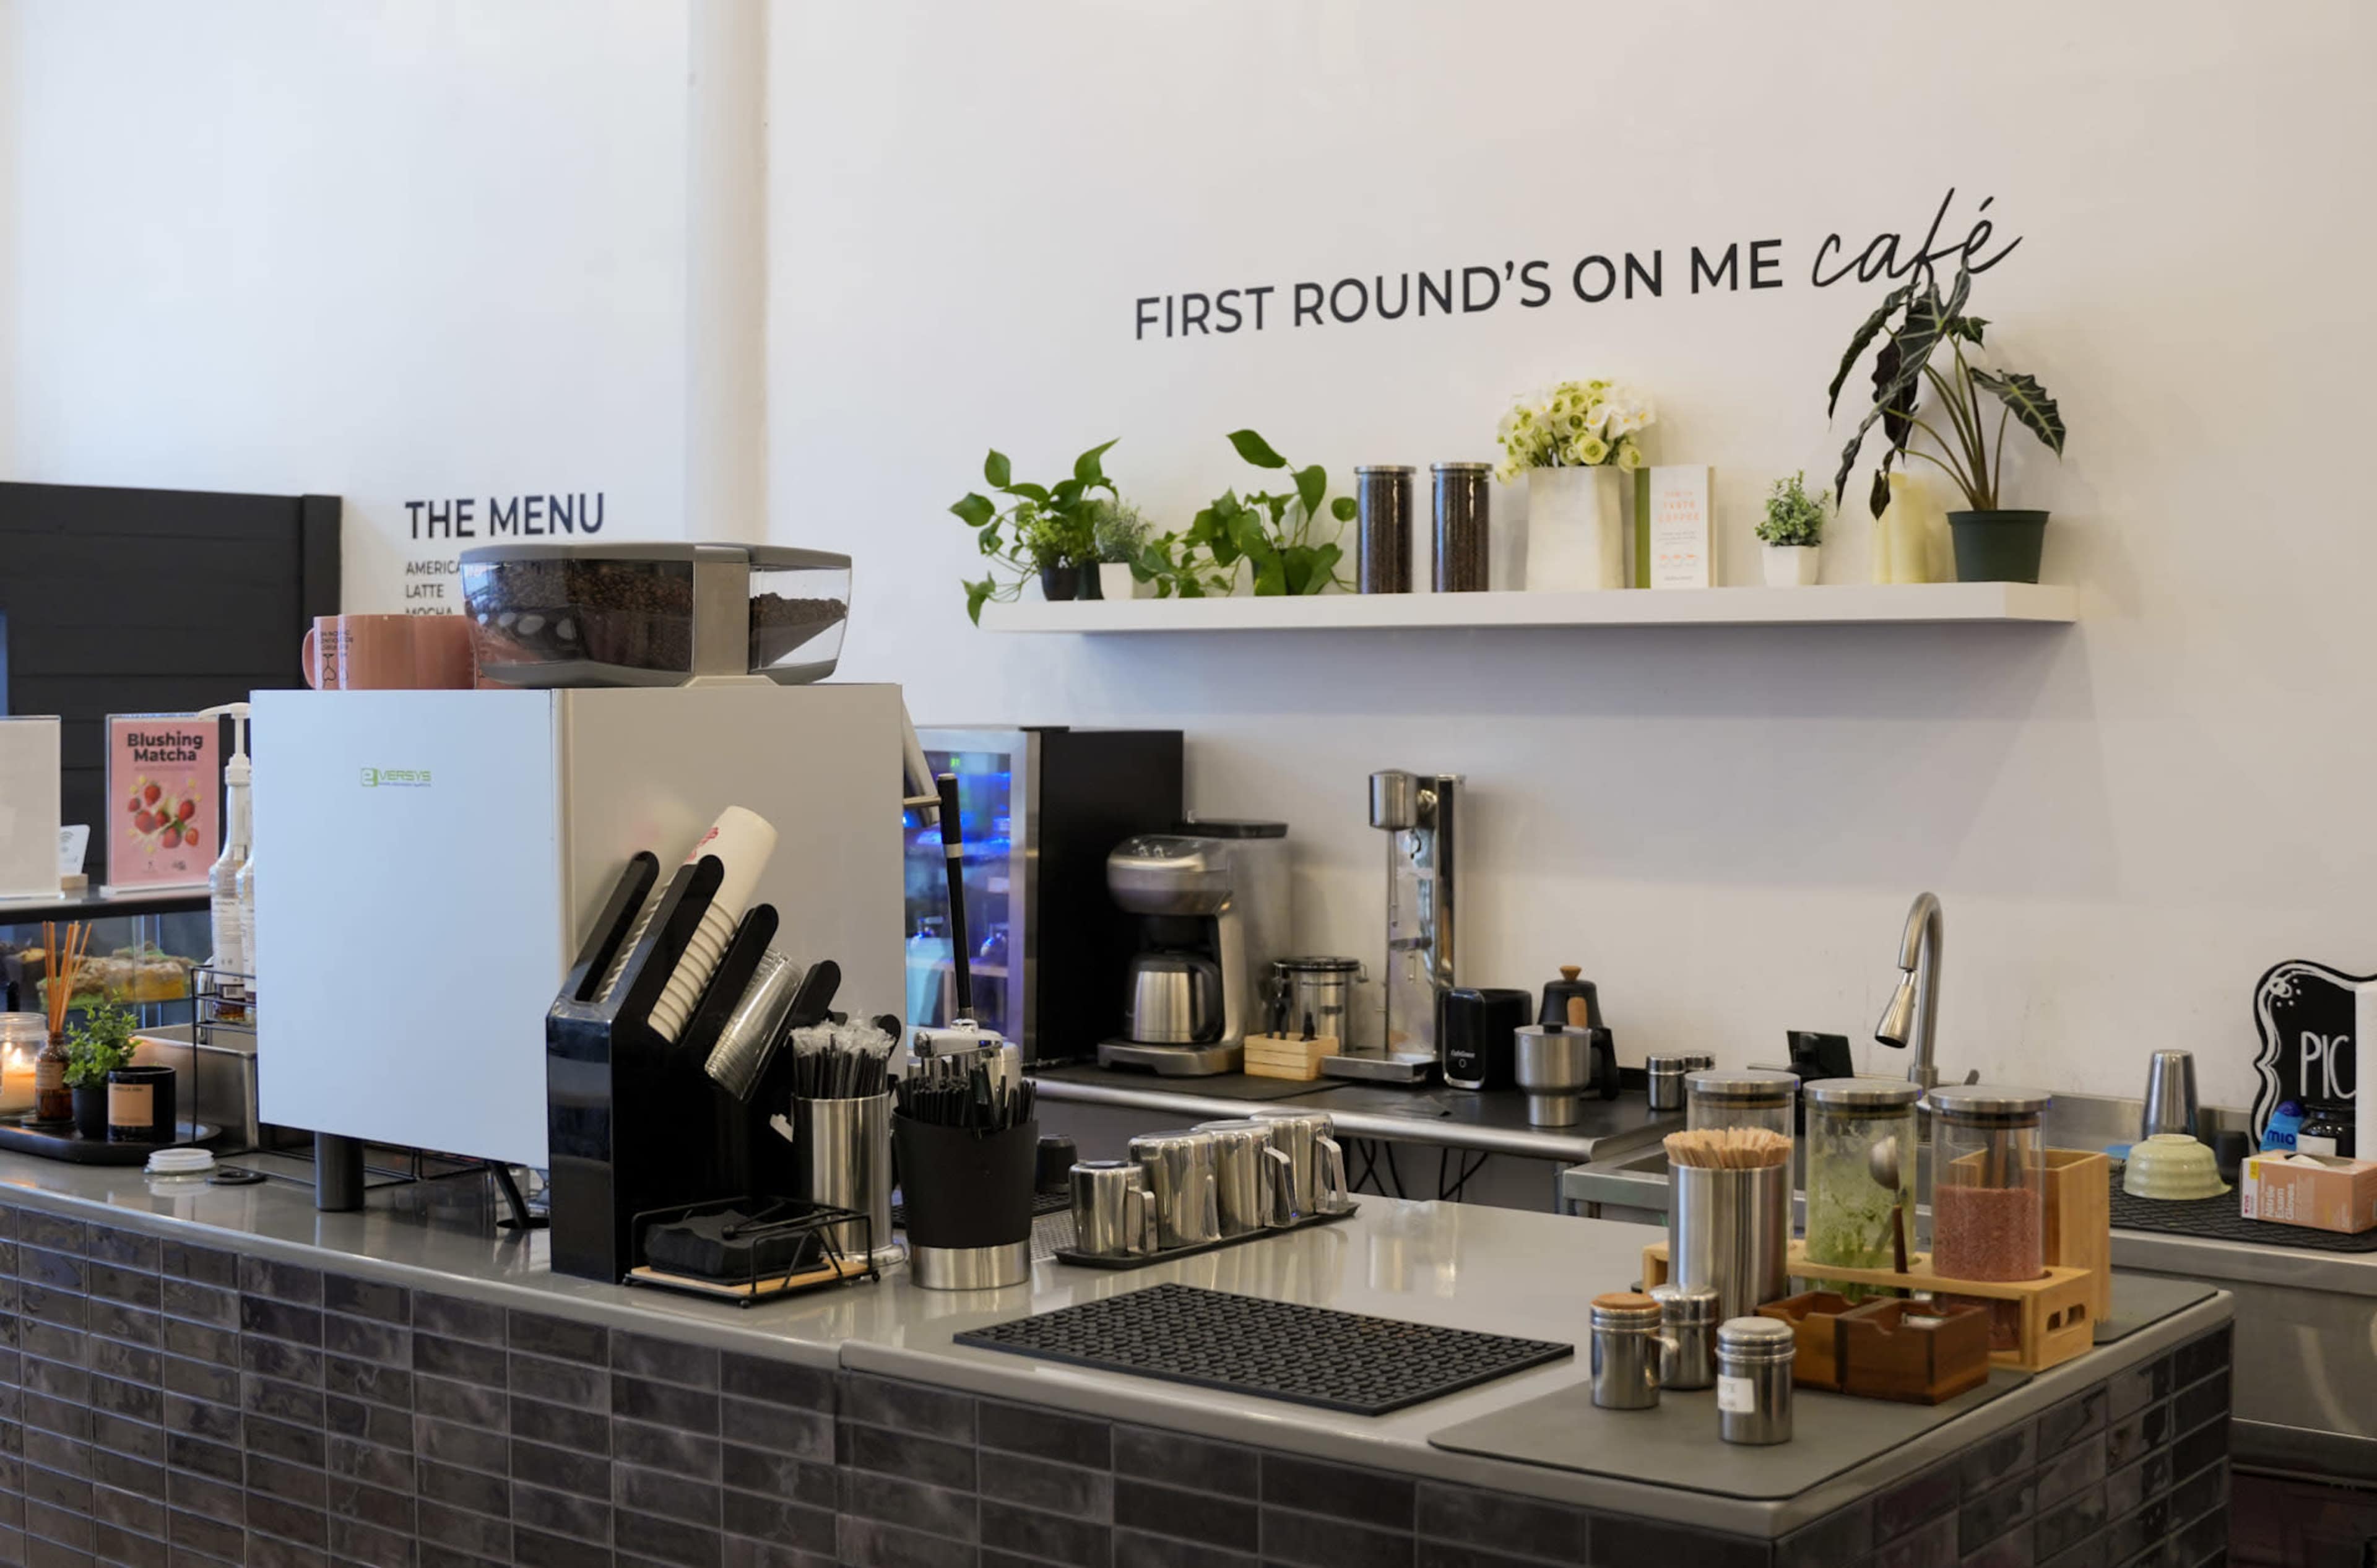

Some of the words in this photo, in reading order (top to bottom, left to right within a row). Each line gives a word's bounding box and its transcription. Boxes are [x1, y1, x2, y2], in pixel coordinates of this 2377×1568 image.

[1136, 286, 1275, 340] FIRST
[1294, 260, 1552, 327] ROUND'S
[1572, 249, 1663, 303] ON
[1690, 238, 1783, 295] ME
[1811, 186, 2023, 297] café
[405, 498, 476, 539] THE
[490, 492, 604, 537] MENU
[406, 583, 444, 599] LATTE
[126, 730, 204, 749] Blushing
[133, 748, 197, 763] Matcha
[2300, 1030, 2356, 1099] PIC
